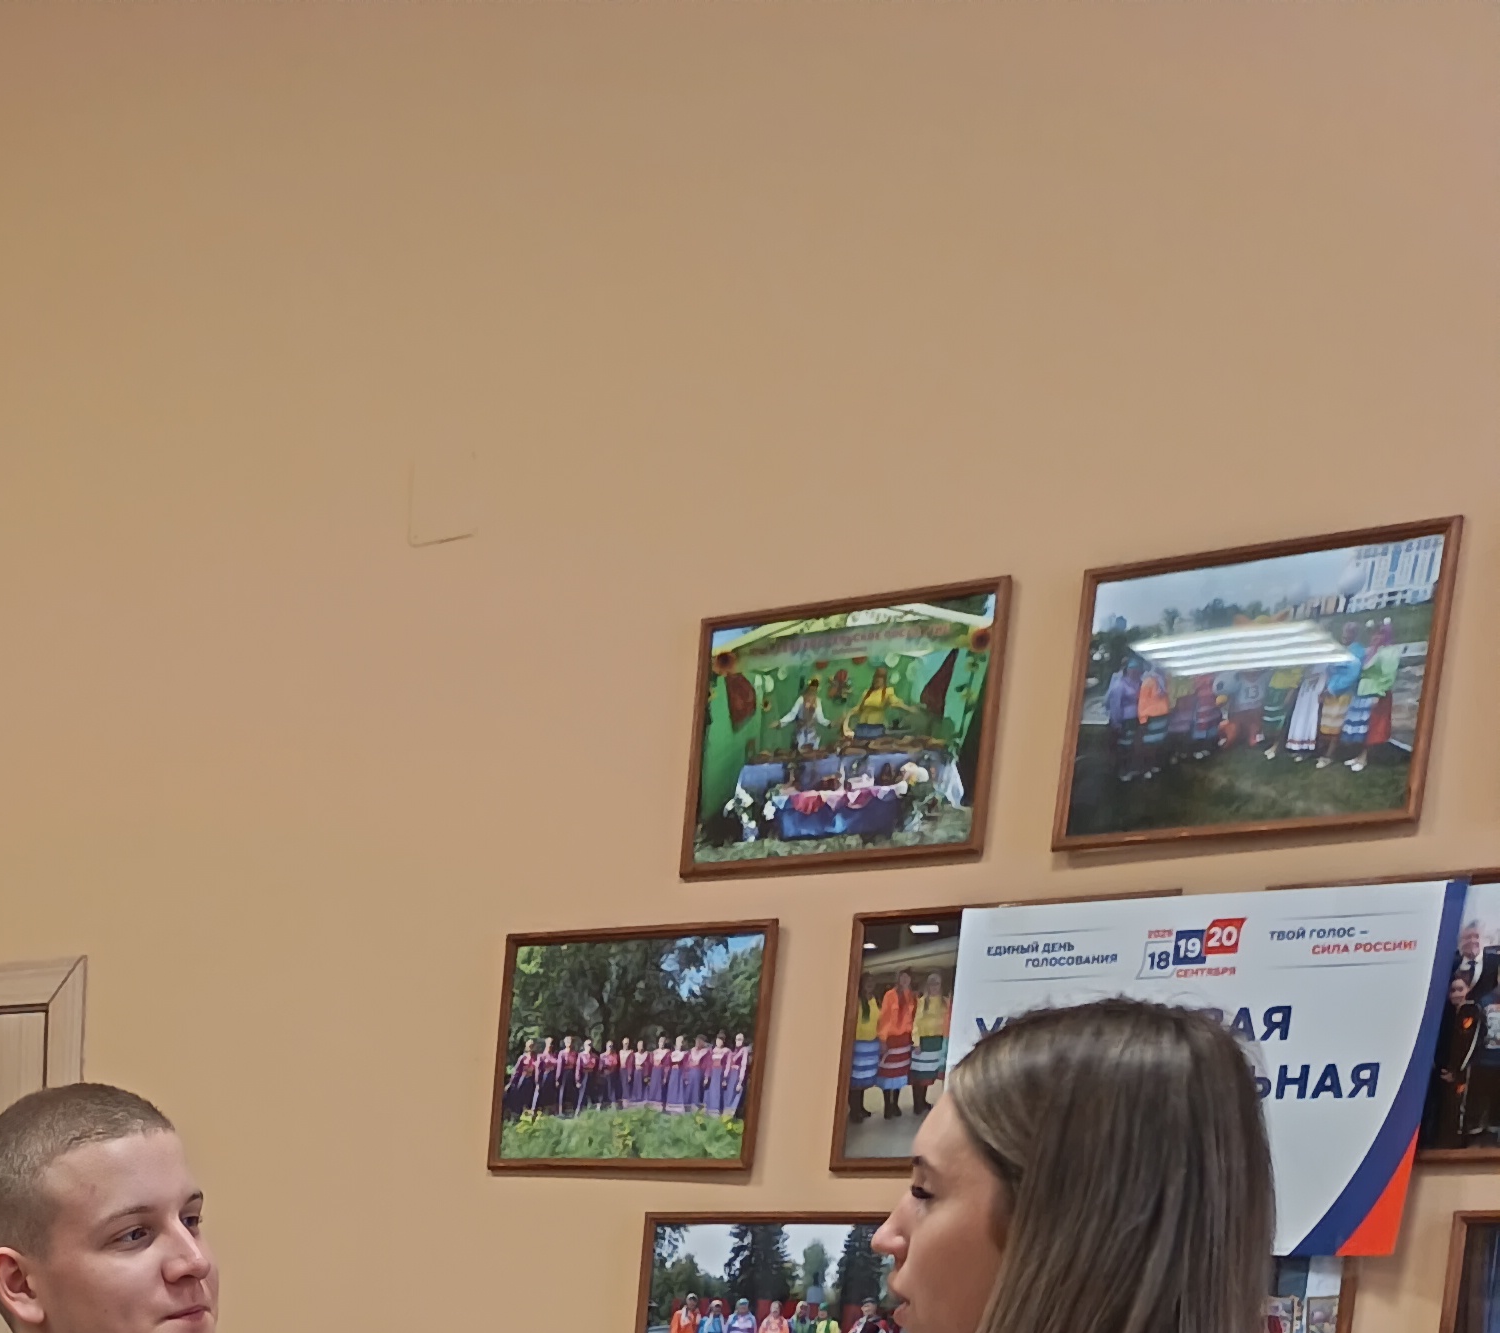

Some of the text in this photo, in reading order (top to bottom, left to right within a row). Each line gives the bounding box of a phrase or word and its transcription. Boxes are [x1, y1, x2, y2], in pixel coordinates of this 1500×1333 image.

[1268, 926, 1306, 941] ТВОЙ
[1308, 926, 1356, 940] ГОЛОС
[986, 940, 1075, 957] ЕДИНЫЙ ДЕНЬ
[1147, 925, 1238, 971] 18 19 20
[1310, 939, 1418, 956] СИЛА РОССИИ!
[1024, 953, 1118, 969] ГОЛОСОВАНИЯ
[1175, 966, 1237, 979] СЕНТЯБРЯ
